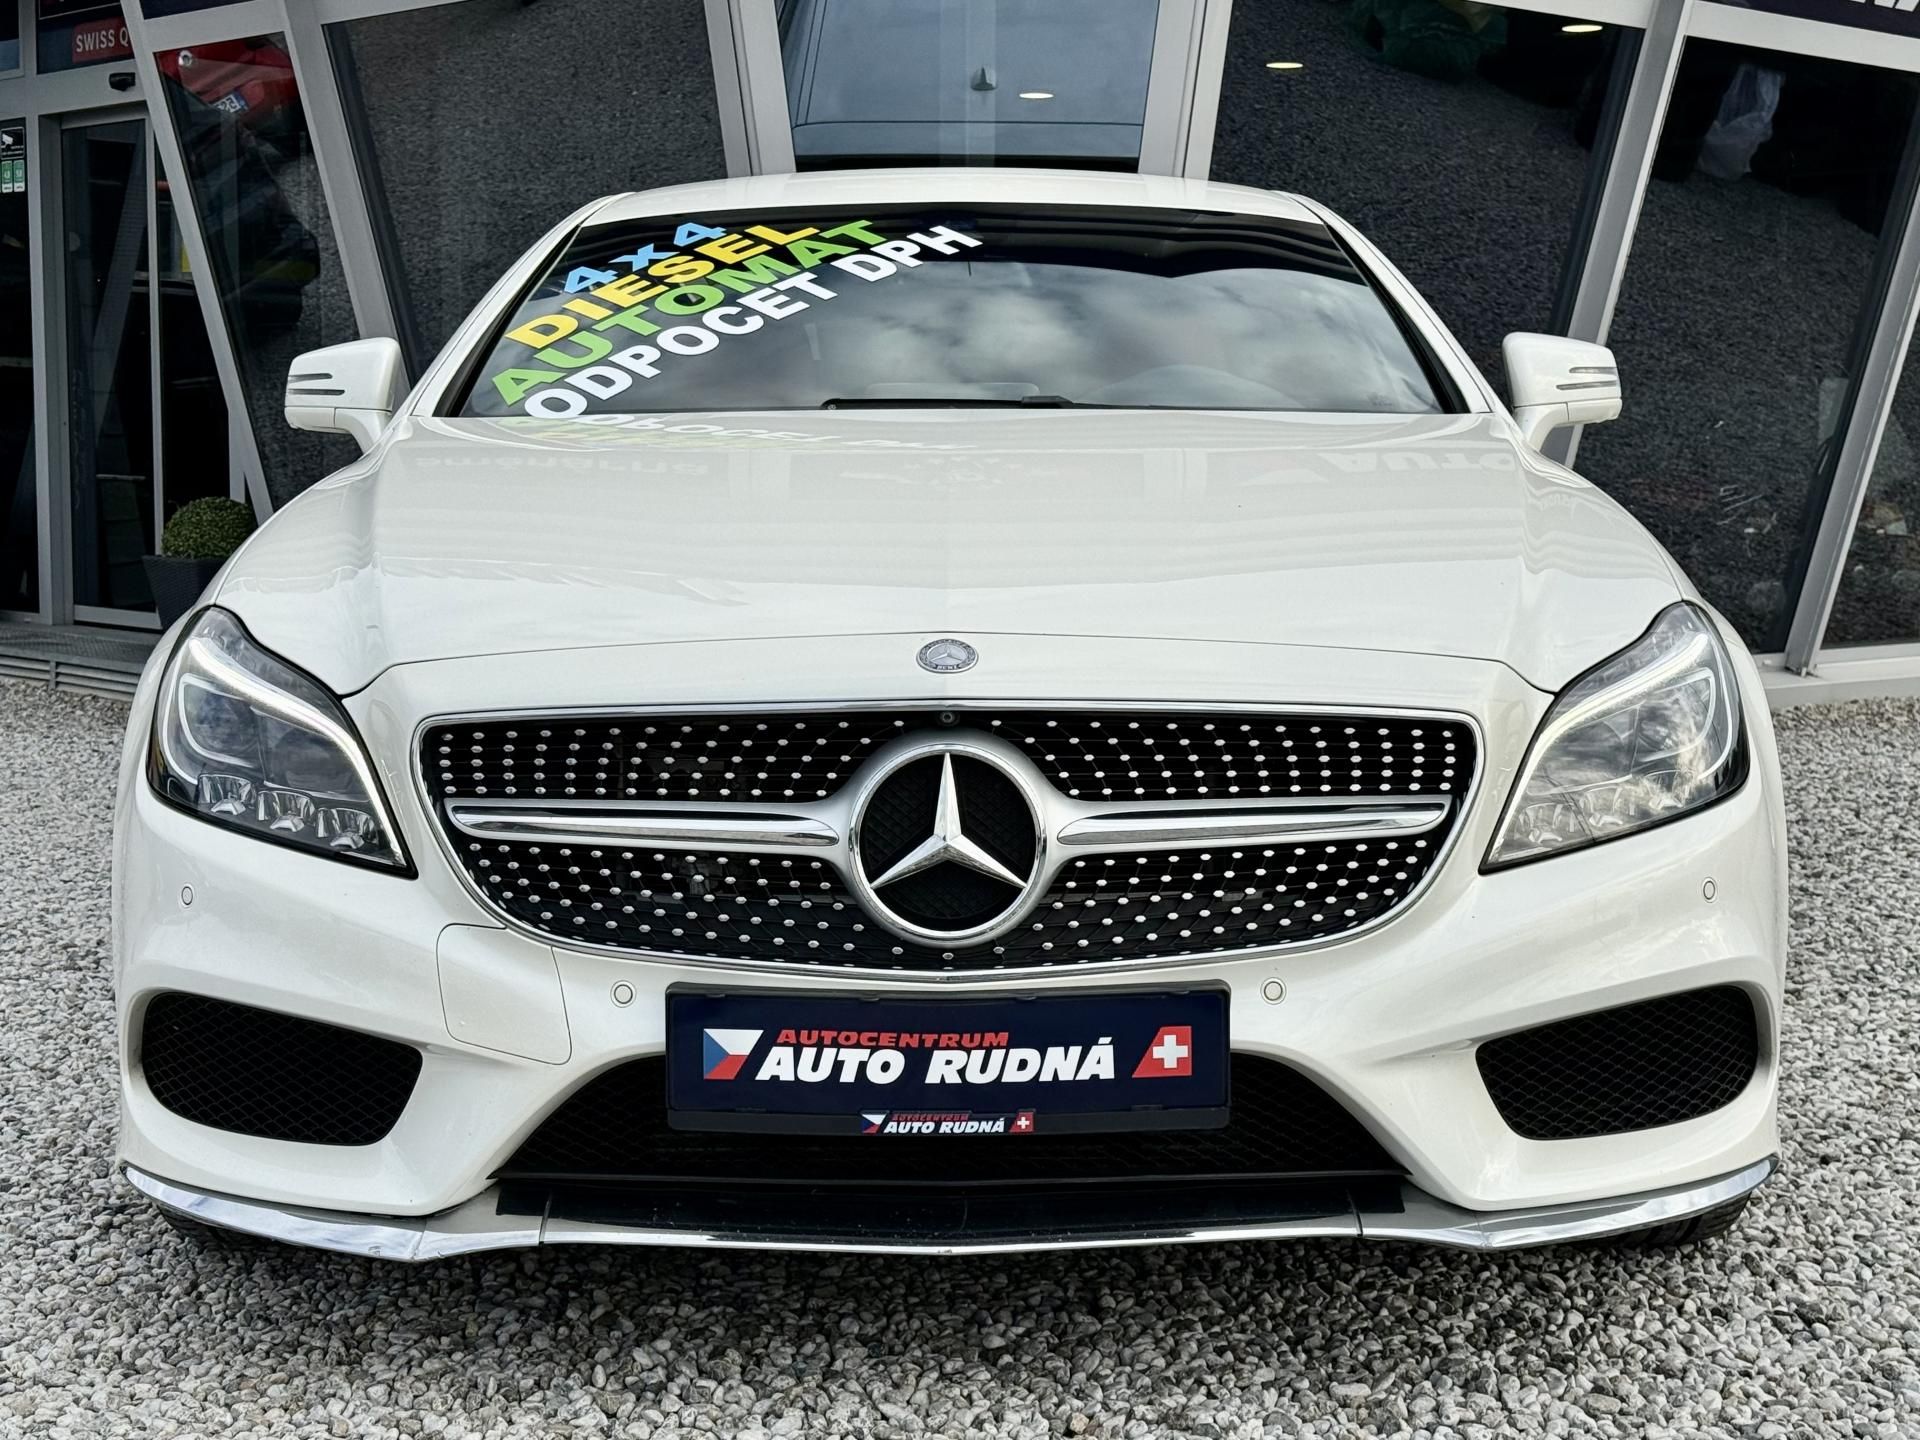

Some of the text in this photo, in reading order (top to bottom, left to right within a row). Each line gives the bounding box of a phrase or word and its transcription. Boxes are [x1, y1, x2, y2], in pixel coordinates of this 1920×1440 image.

[76, 29, 115, 52] SWISS
[504, 225, 820, 349] DIESEL
[491, 219, 887, 406] AUTOMAT
[524, 225, 983, 419] ODPOCET DPH
[776, 1029, 1009, 1048] AUTOCENTRUM
[754, 1037, 1115, 1085] AUTO RUDNÁ
[884, 1118, 1005, 1134] AUTO RUDNÁ
[892, 1113, 970, 1121] AUTOCENTRUM
